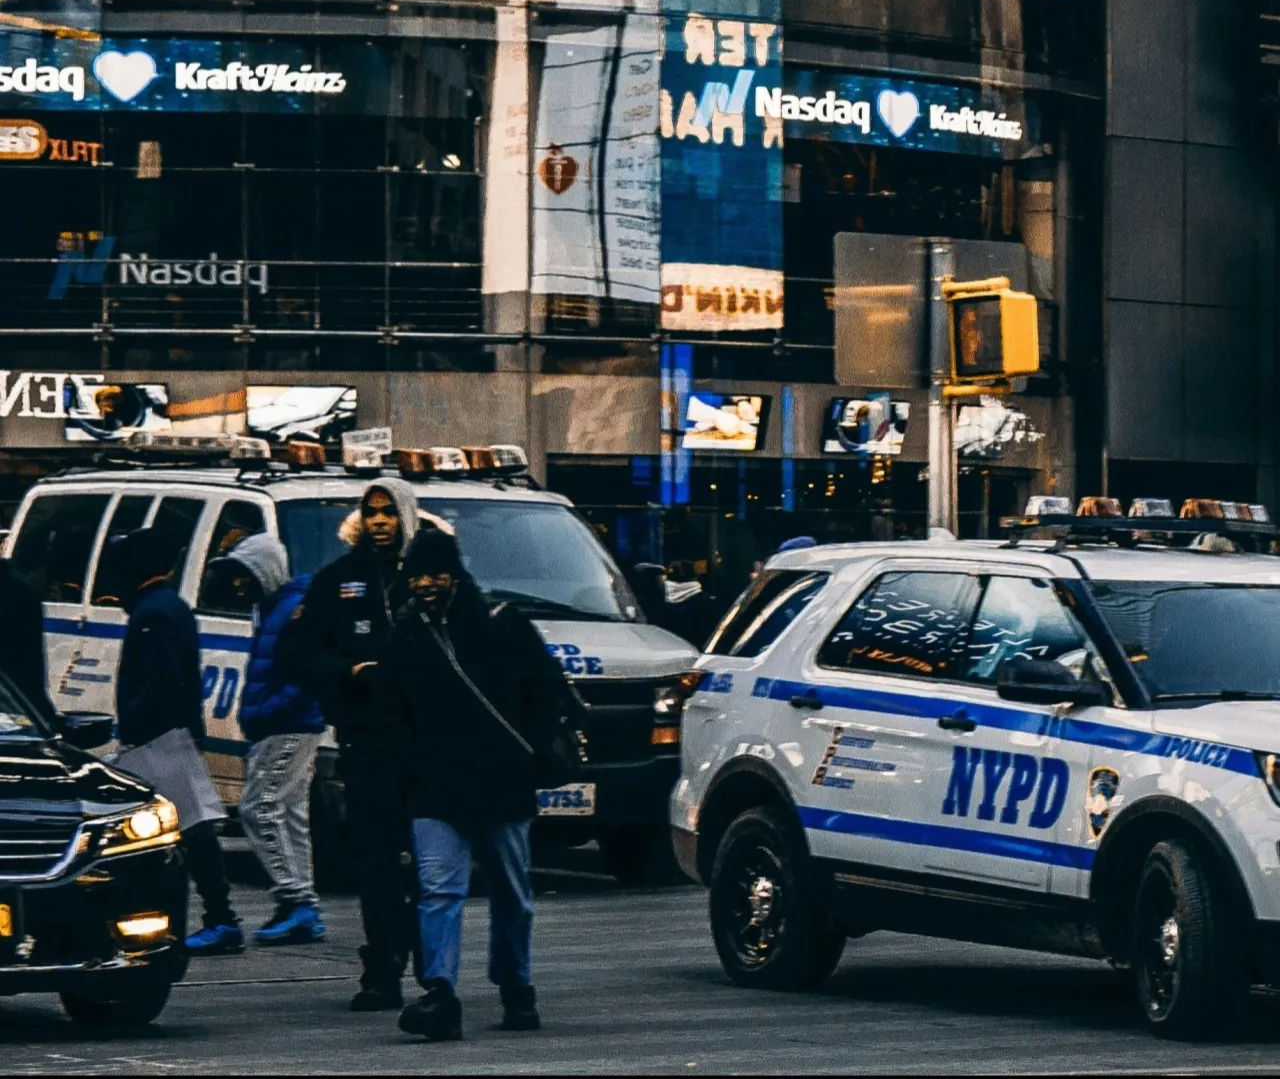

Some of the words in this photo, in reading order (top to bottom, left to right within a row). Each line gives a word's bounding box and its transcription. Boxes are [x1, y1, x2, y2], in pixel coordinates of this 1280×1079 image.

[755, 86, 870, 133] Nasdaq
[119, 252, 268, 294] Nasdaq
[1166, 737, 1229, 767] POLICE
[942, 746, 1070, 829] NYPD
